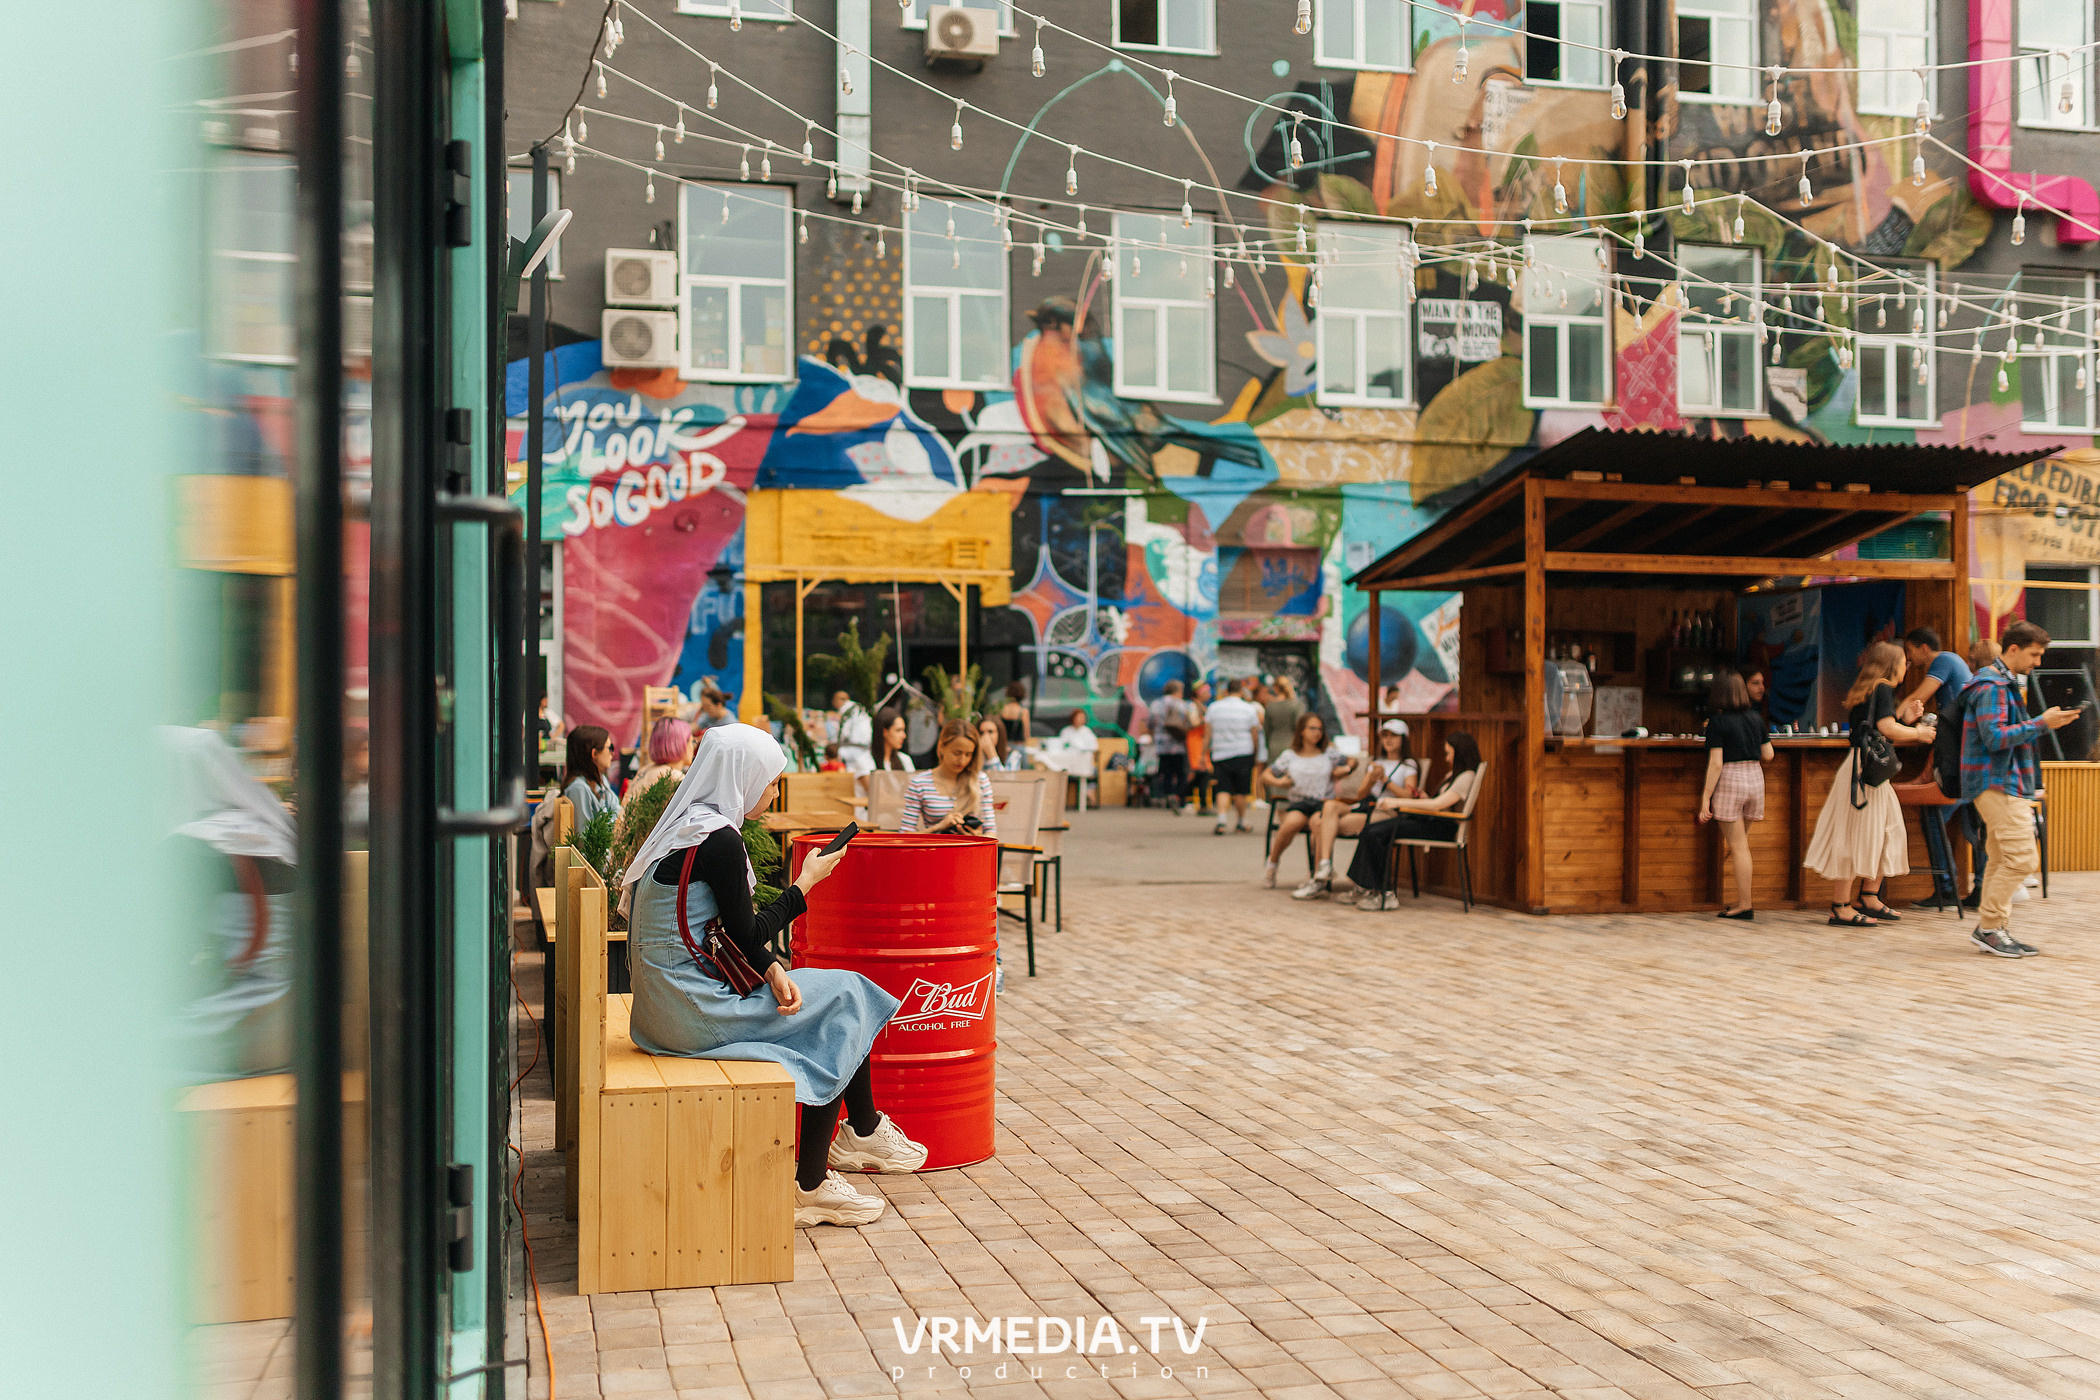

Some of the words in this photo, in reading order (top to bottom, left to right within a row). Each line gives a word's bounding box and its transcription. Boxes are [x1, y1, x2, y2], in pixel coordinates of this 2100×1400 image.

[915, 981, 977, 1013] Bud
[898, 1022, 947, 1032] ALCOHOL
[950, 1019, 972, 1029] FREE
